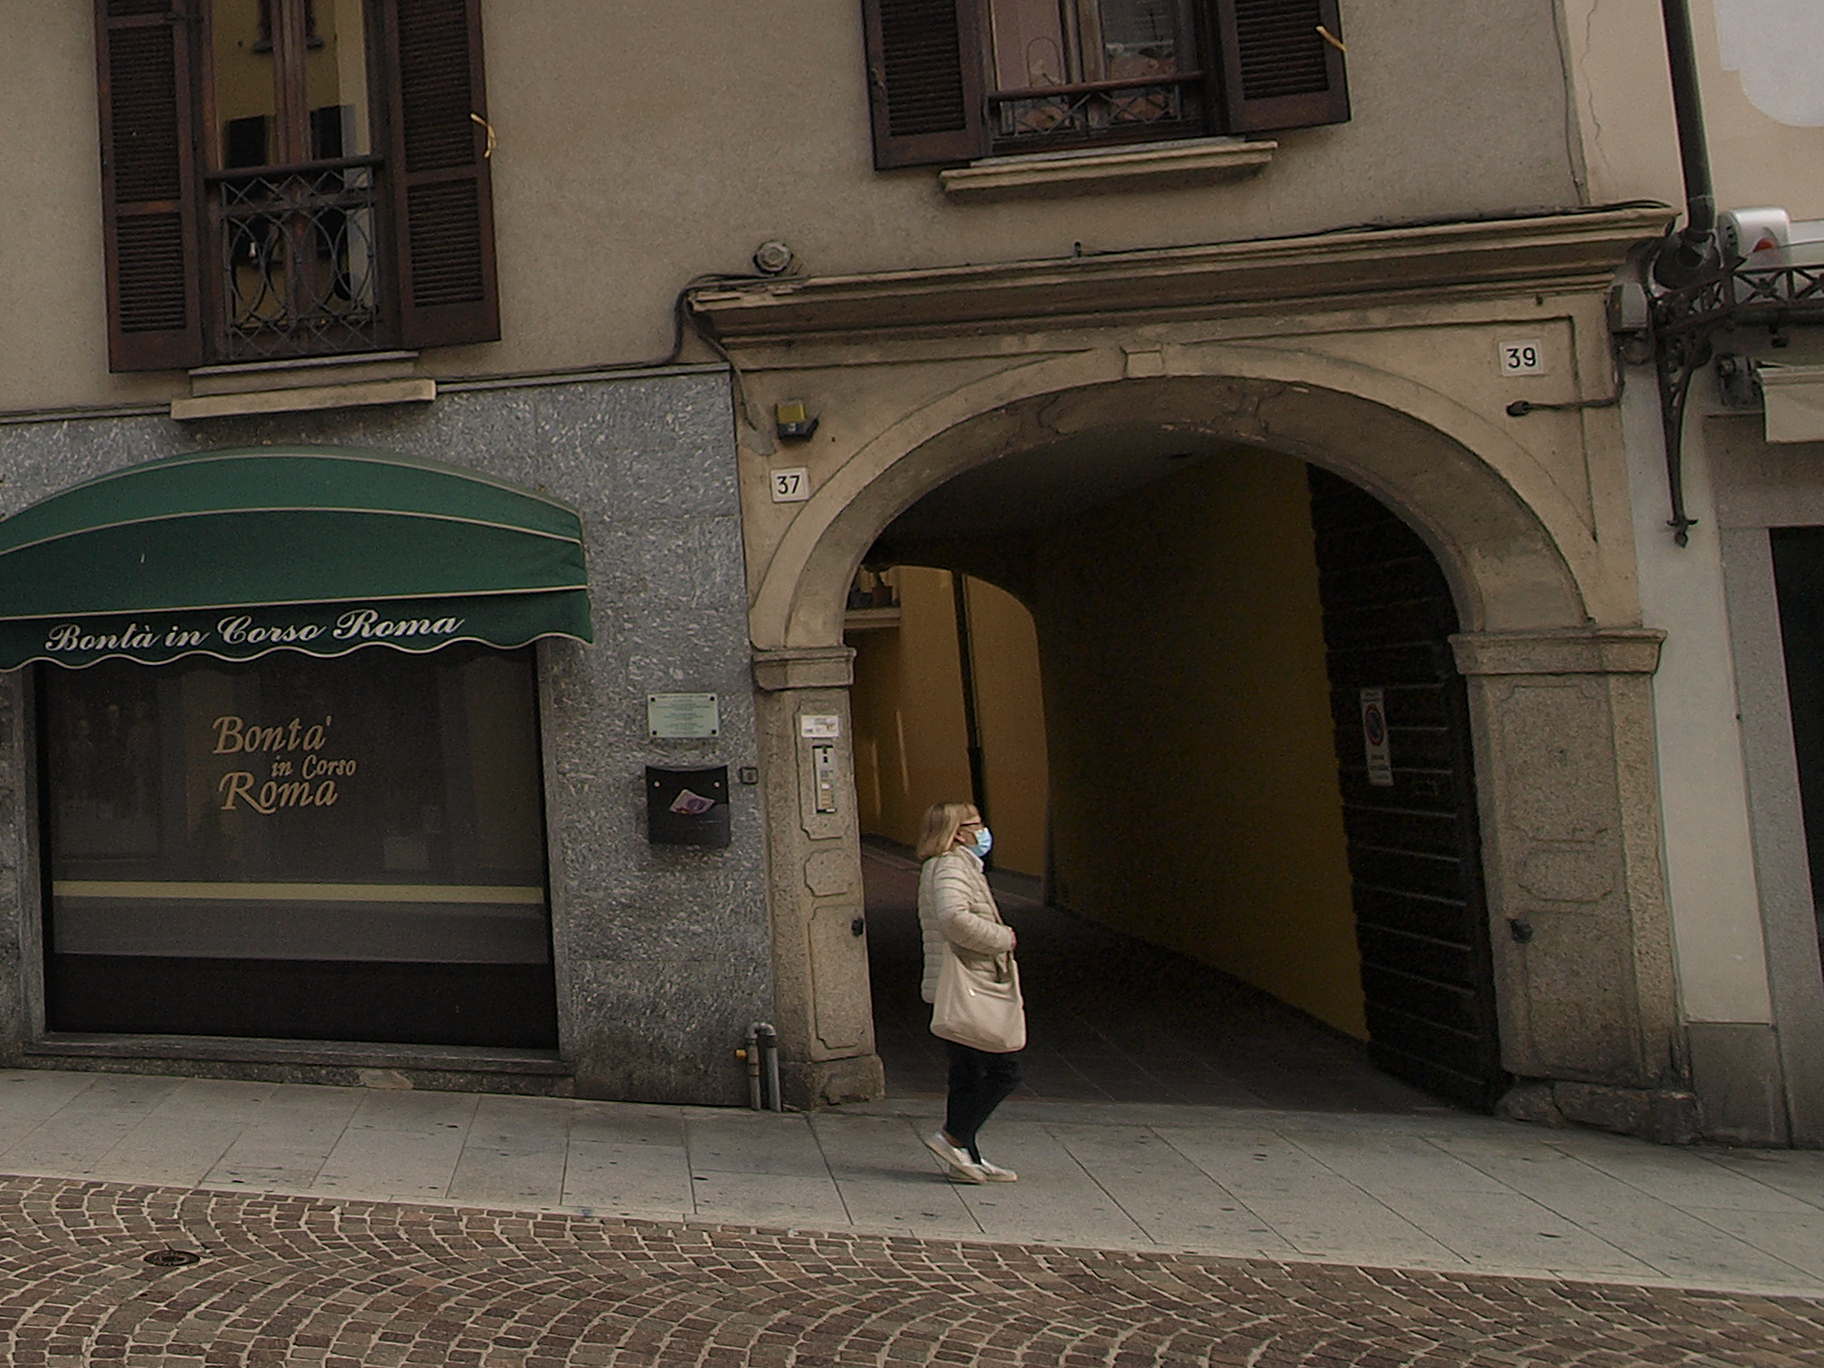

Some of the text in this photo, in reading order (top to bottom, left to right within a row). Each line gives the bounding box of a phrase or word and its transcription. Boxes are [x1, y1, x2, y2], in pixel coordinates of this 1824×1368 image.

[1506, 347, 1537, 369] 39
[776, 474, 800, 495] 37
[47, 608, 467, 652] Bontà in Corso Roma
[270, 753, 358, 781] in Corso
[218, 770, 340, 815] Roma
